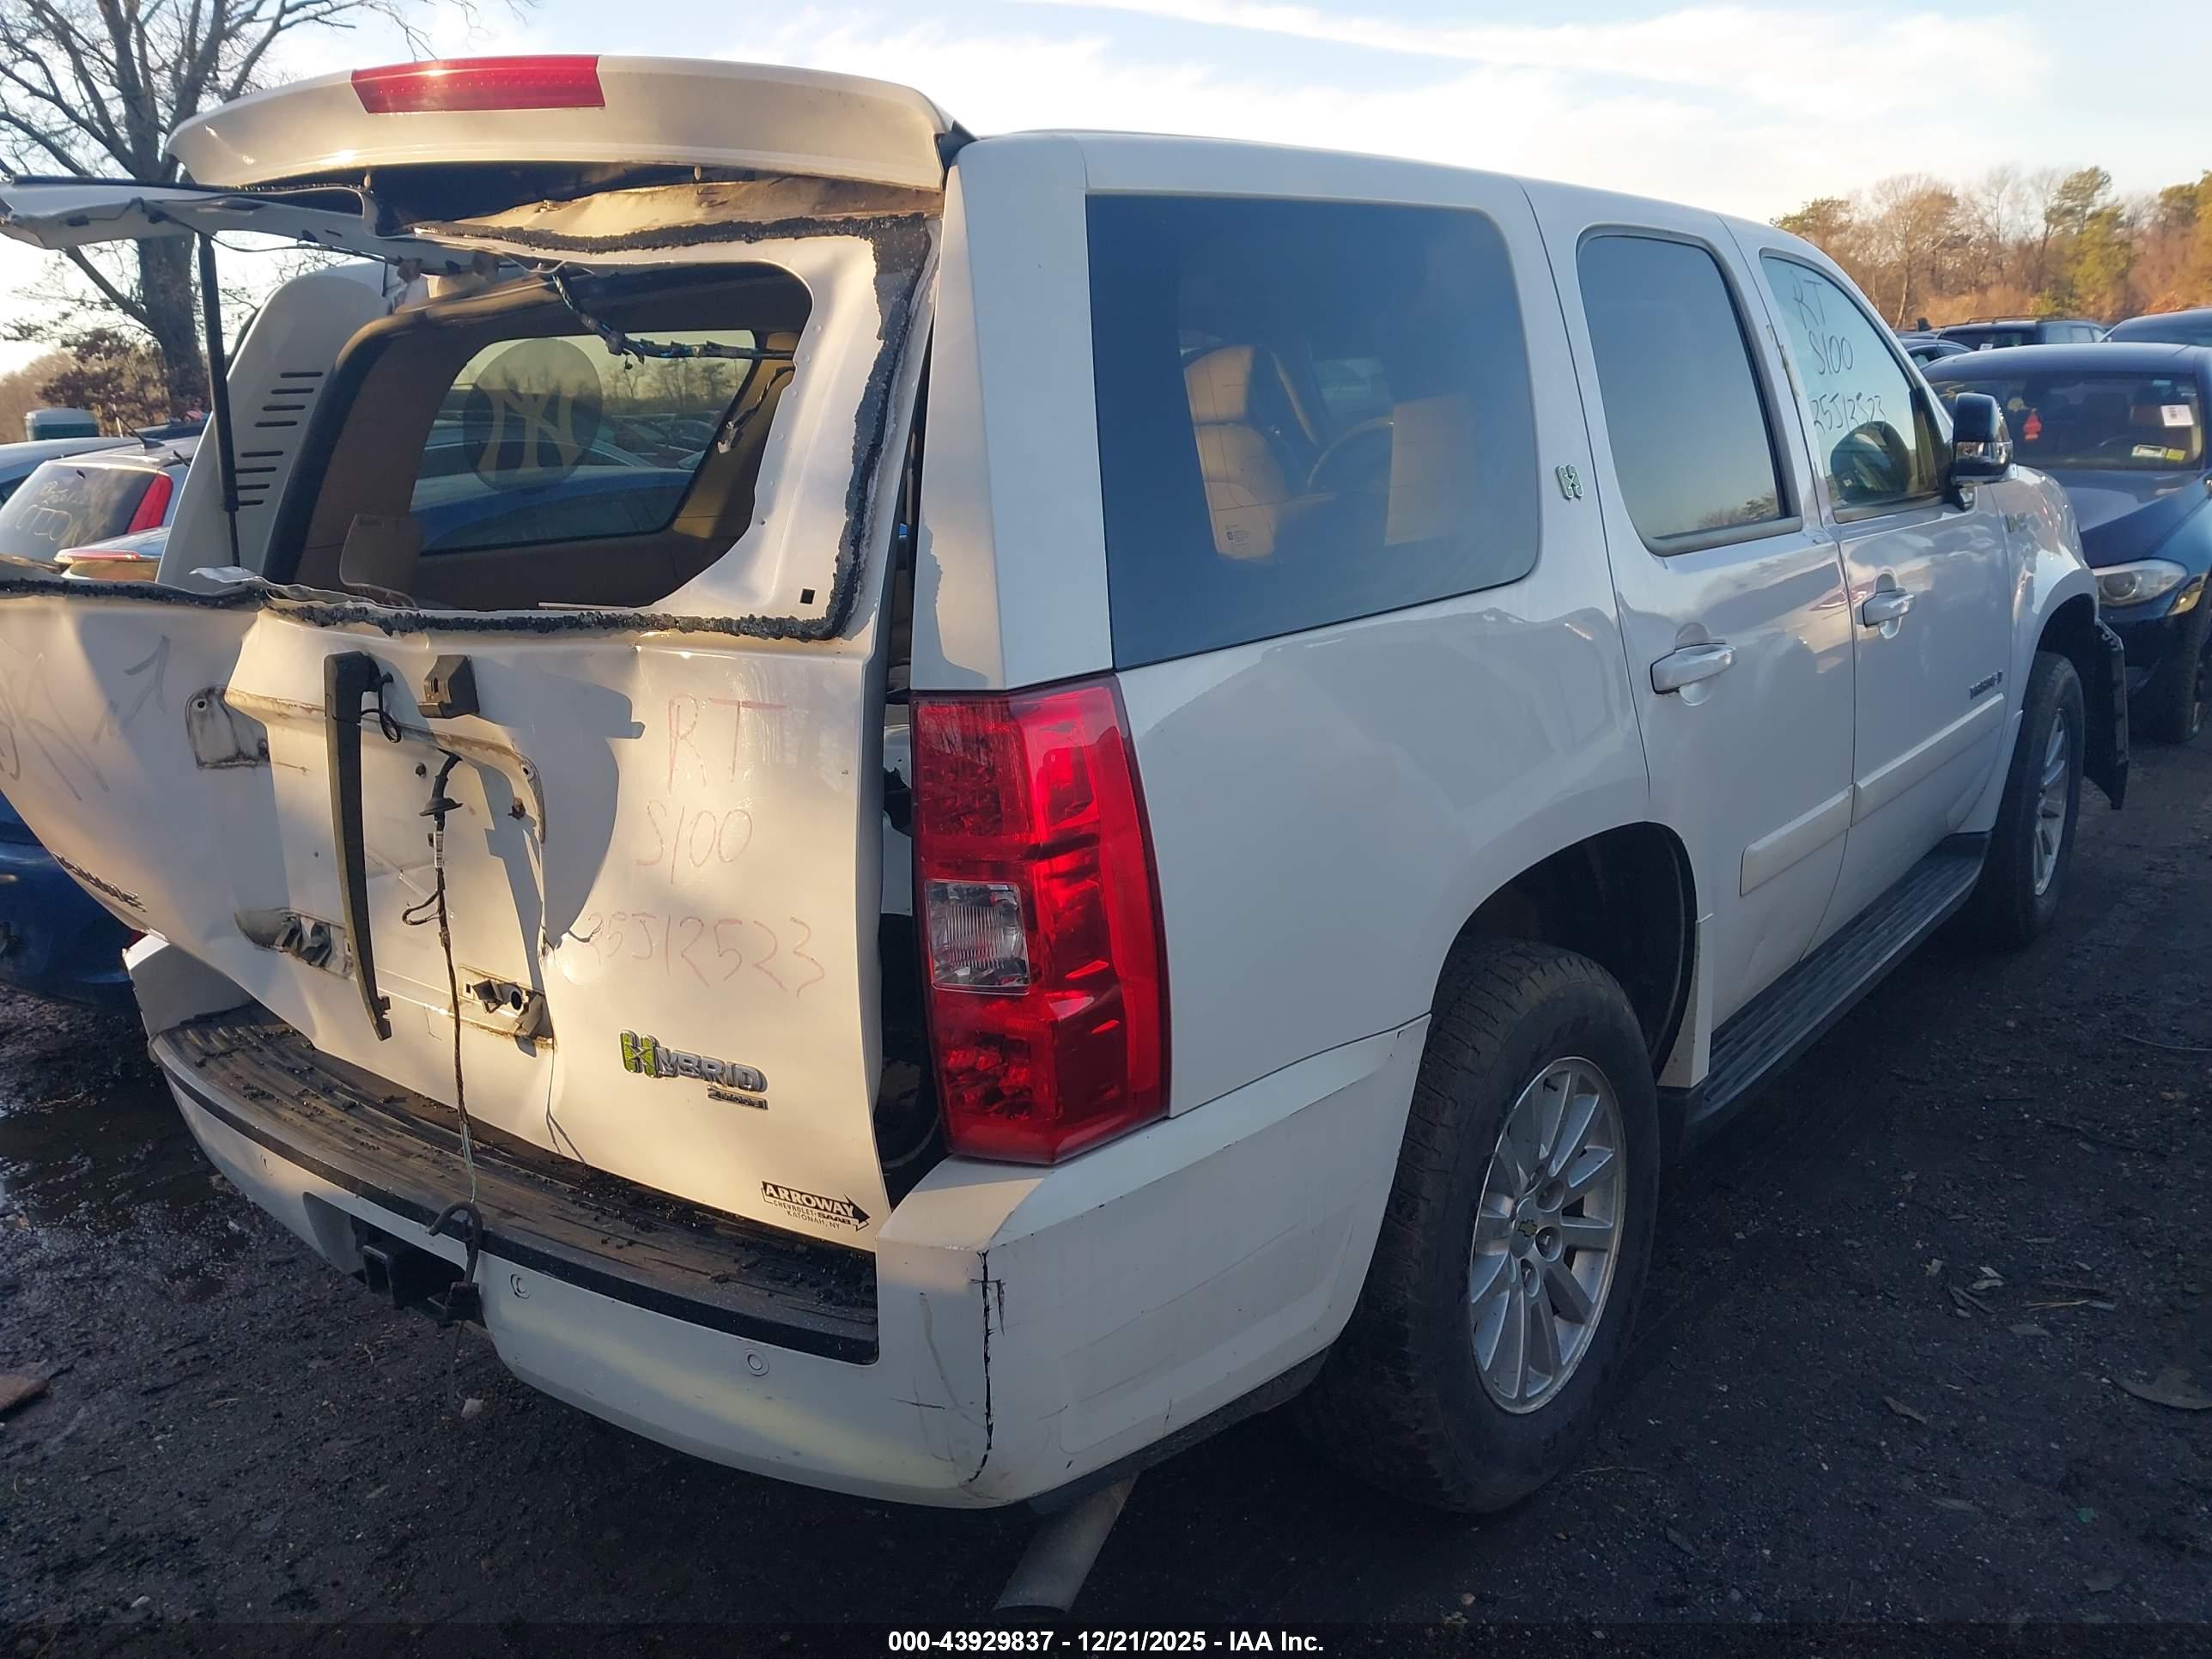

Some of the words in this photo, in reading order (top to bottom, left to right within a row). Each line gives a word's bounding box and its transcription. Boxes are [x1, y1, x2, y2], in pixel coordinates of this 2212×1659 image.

[1791, 273, 1826, 330] RT
[1808, 330, 1854, 375] S100
[667, 693, 787, 795] RT
[765, 1183, 855, 1218] ARROWAY
[829, 1221, 841, 1230] NY
